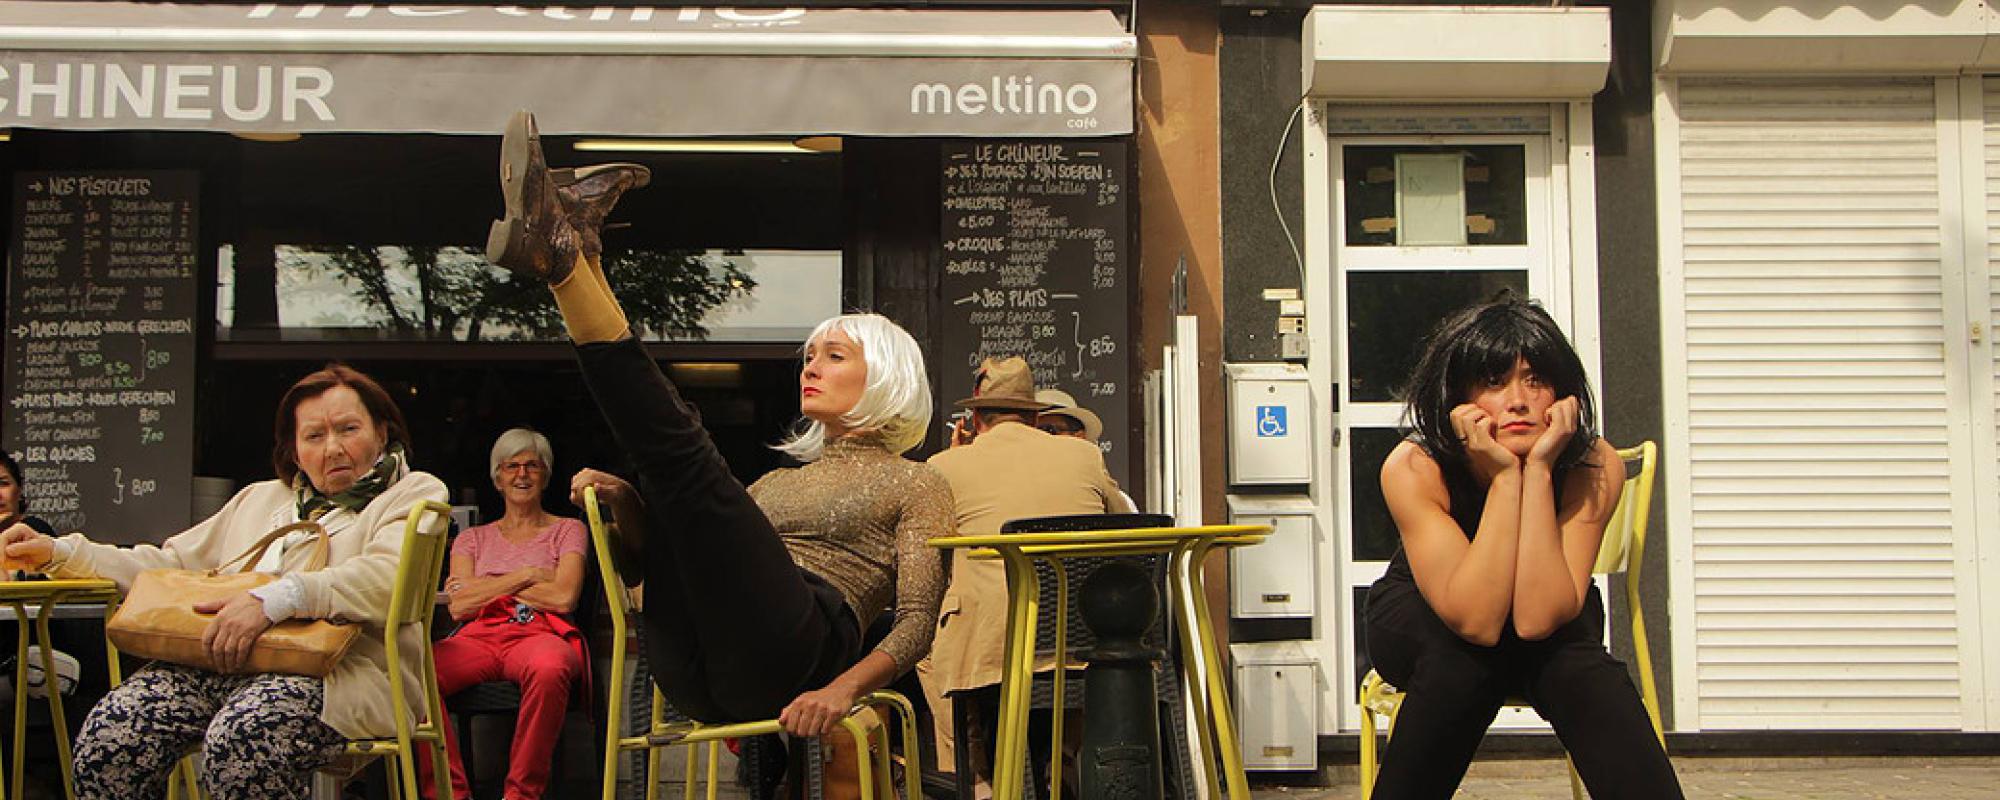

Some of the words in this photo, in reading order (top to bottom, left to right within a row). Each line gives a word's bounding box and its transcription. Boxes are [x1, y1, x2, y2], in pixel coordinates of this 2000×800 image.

[0, 63, 335, 121] HINEUR
[910, 75, 1097, 115] meltino
[1066, 117, 1097, 129] café
[977, 144, 993, 161] LE
[997, 143, 1068, 163] CHINEUR
[48, 177, 76, 196] NOS
[957, 236, 1004, 254] CROQUE
[1008, 288, 1047, 308] PLATS
[26, 446, 48, 463] LES
[49, 443, 97, 465] QUICHES
